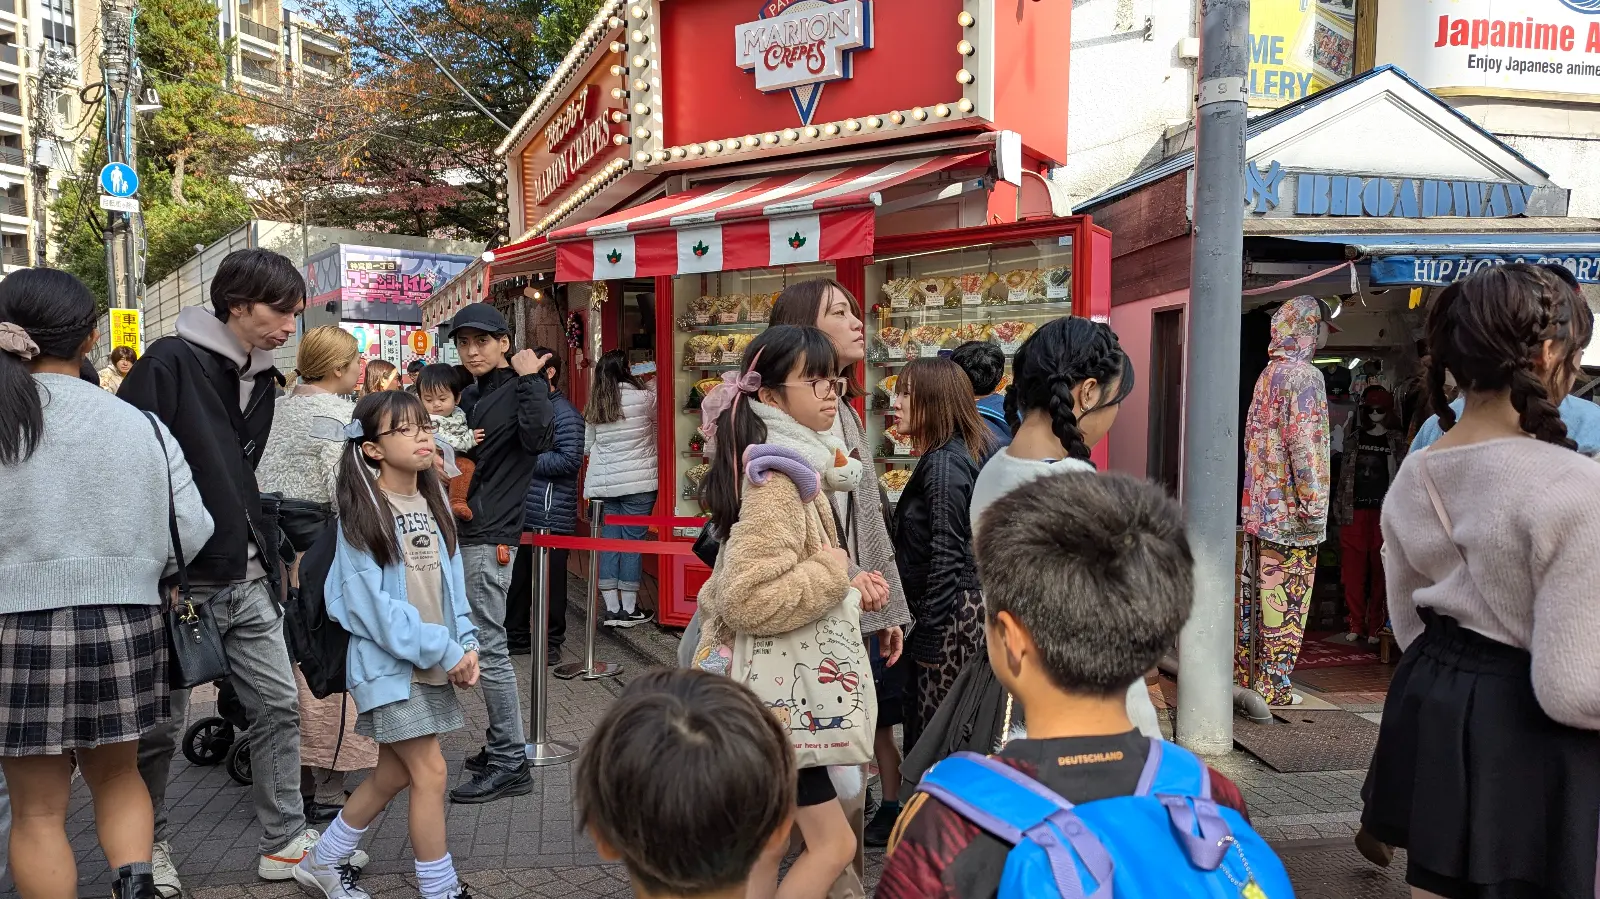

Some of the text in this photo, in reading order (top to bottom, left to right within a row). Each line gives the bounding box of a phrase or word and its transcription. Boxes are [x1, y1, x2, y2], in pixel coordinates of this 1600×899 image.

[743, 9, 850, 56] MARION
[1434, 14, 1575, 52] Japanime
[763, 39, 826, 75] CREPES
[1249, 33, 1285, 65] ME
[1467, 54, 1502, 73] Enjoy
[1505, 56, 1563, 75] Japanese
[1249, 68, 1313, 99] LERY
[534, 149, 569, 206] MARION
[1294, 174, 1535, 218] BROADWAY
[1413, 259, 1453, 284] HIP
[830, 740, 850, 748] smile!
[1057, 751, 1124, 767] DEUTSCHLAND
